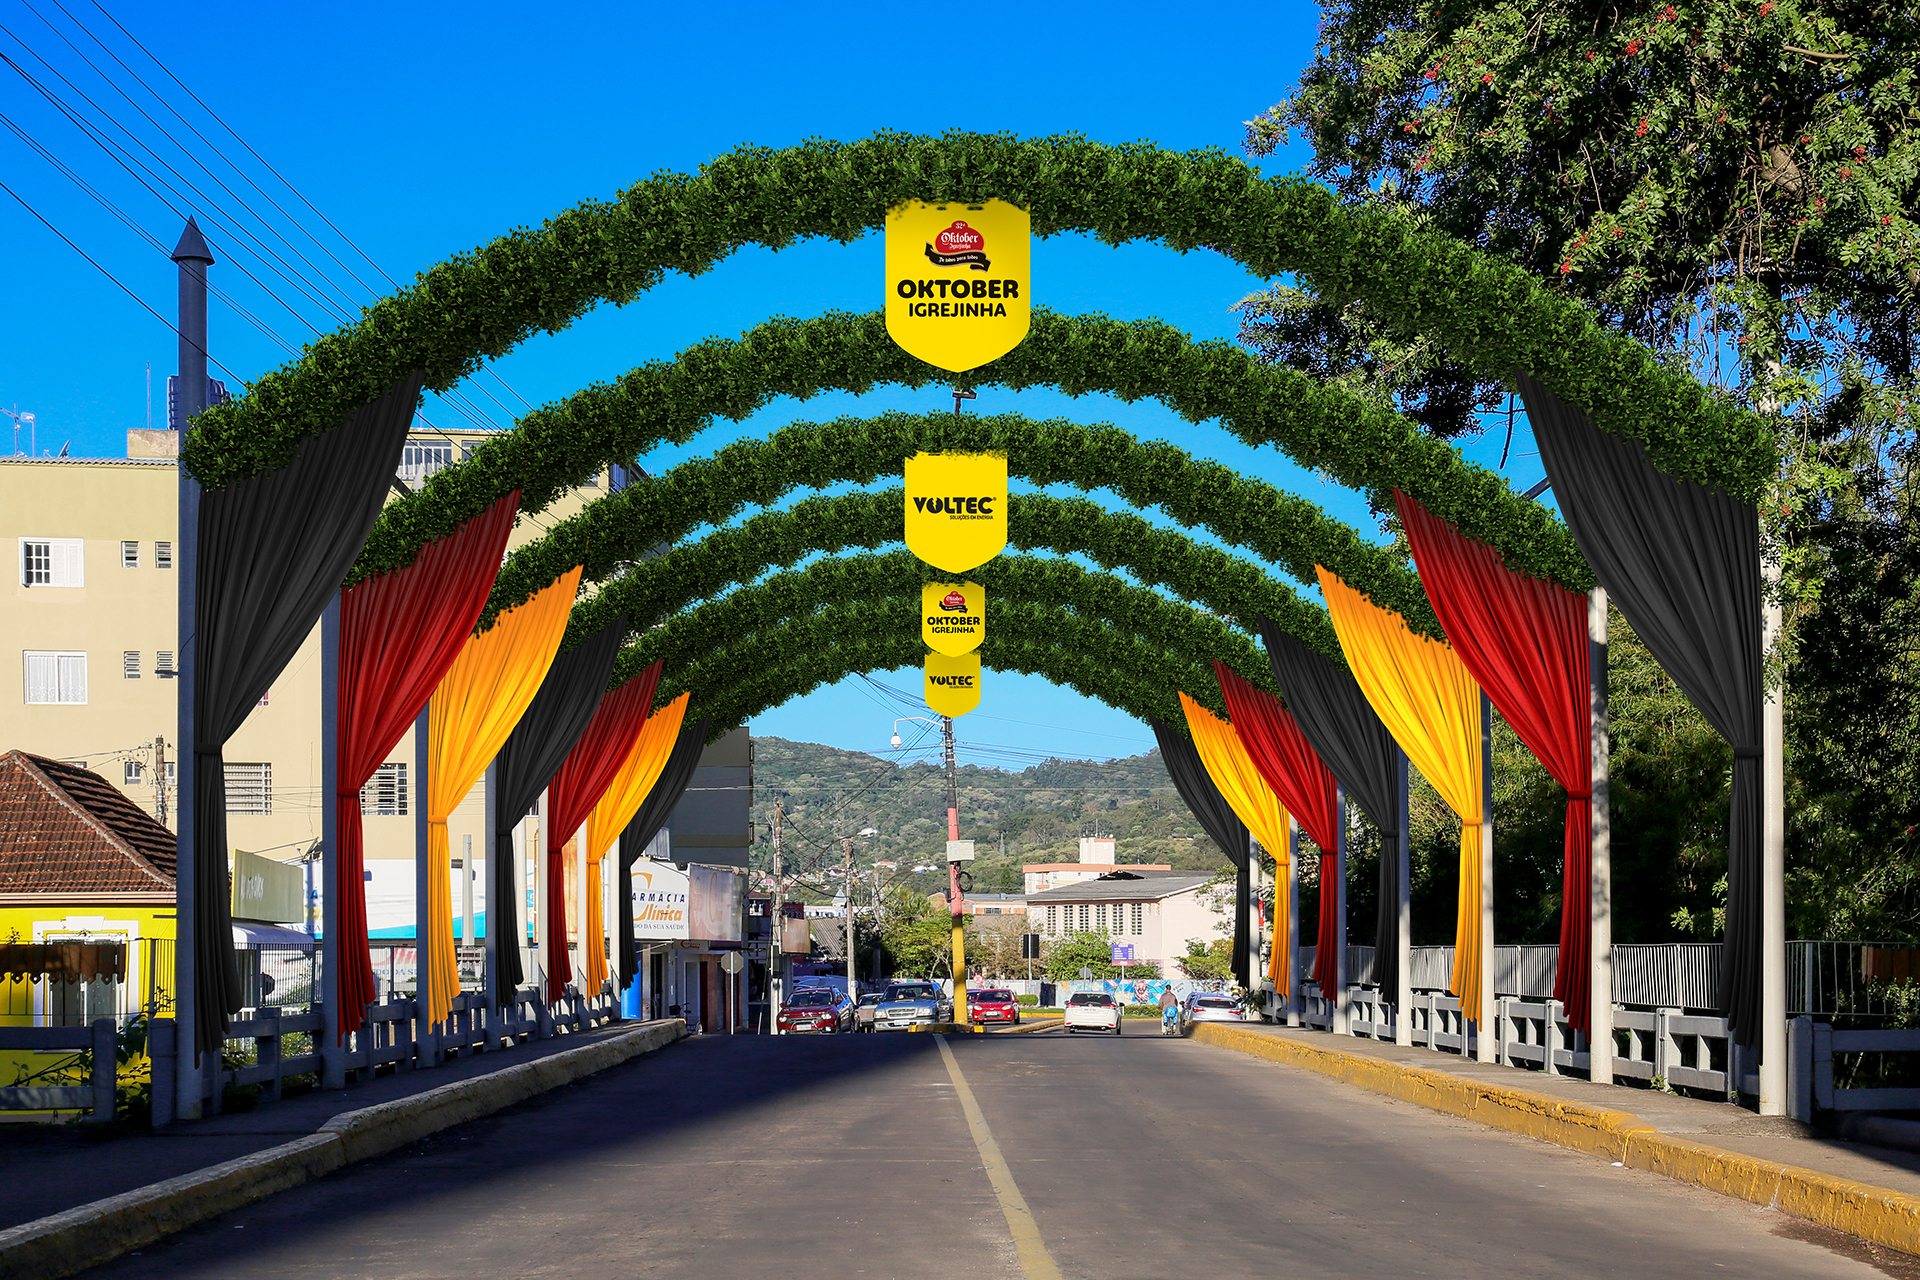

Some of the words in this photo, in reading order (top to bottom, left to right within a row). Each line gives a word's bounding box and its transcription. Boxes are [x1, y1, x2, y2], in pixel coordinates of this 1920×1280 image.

[941, 232, 978, 244] Oktober
[897, 280, 1018, 298] OKTOBER
[909, 303, 1006, 317] IGREJINHA
[913, 497, 993, 514] VOLTEC
[927, 616, 980, 625] OKTOBER
[929, 676, 973, 685] VOLTEC
[632, 891, 684, 902] ARMÁCIA
